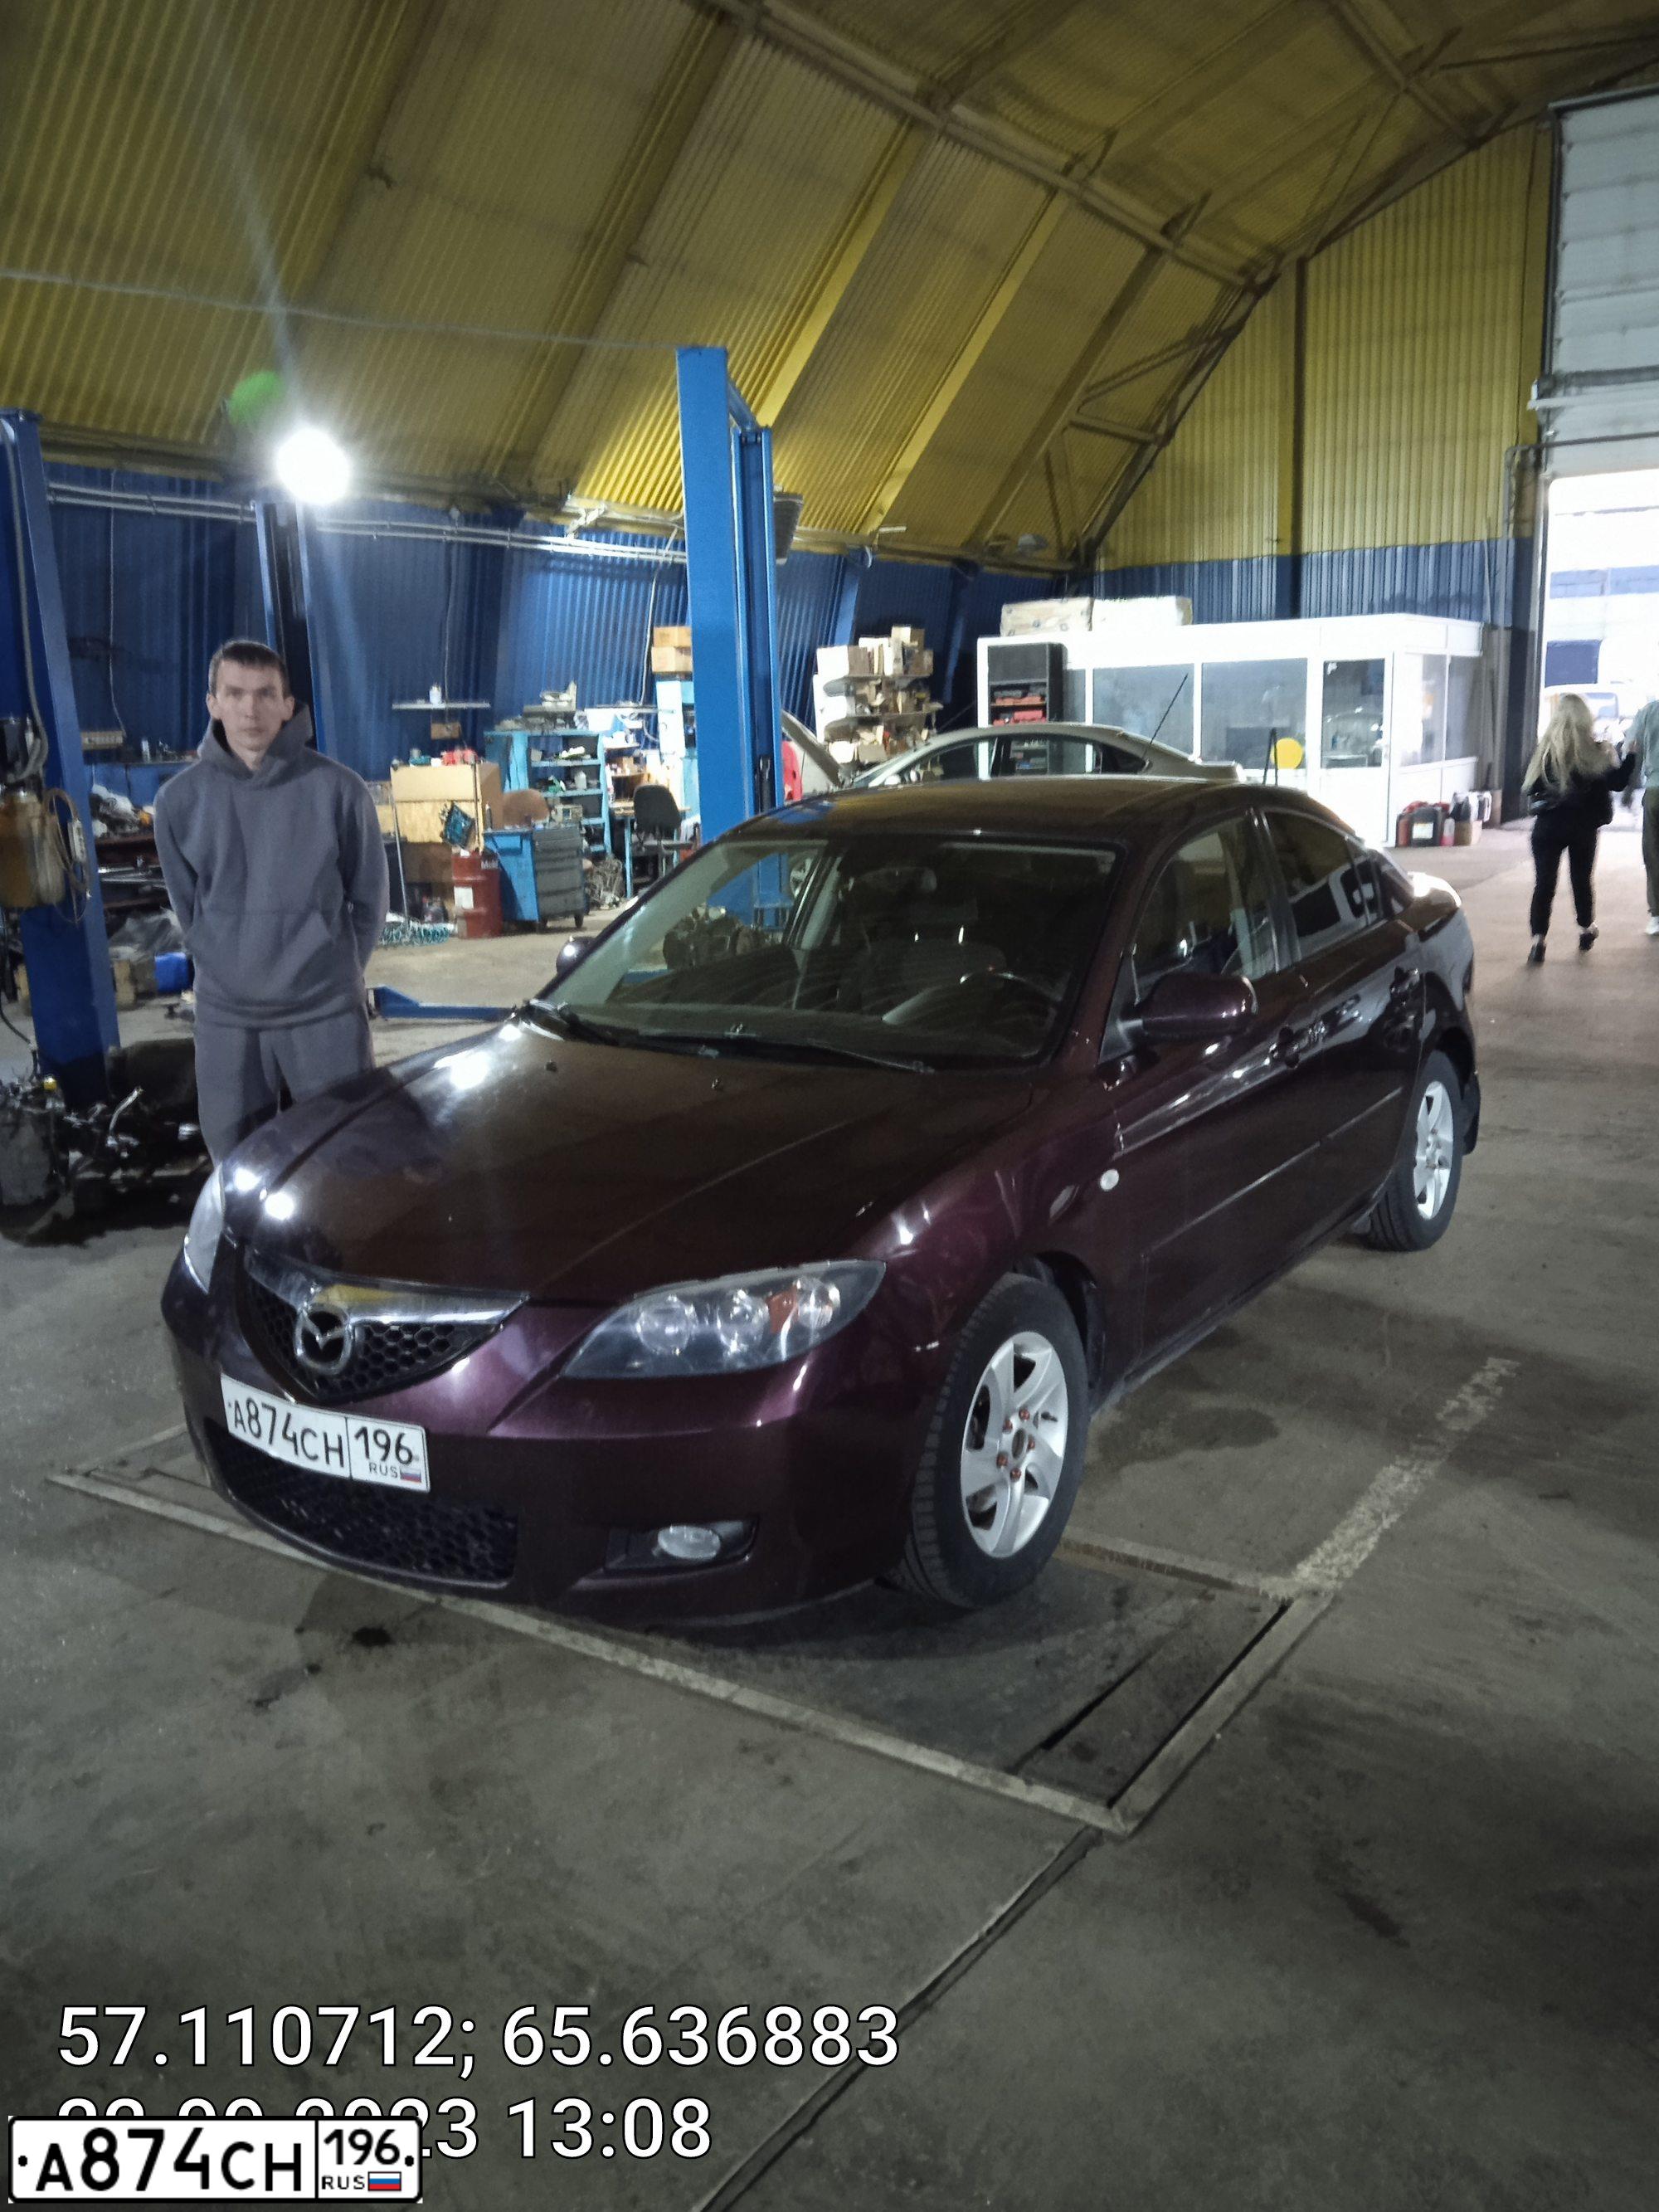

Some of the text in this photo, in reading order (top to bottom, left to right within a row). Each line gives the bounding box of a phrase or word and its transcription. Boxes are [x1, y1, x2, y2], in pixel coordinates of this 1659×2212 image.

[233, 1398, 413, 1469] А874СН 196
[368, 1461, 398, 1479] RUS
